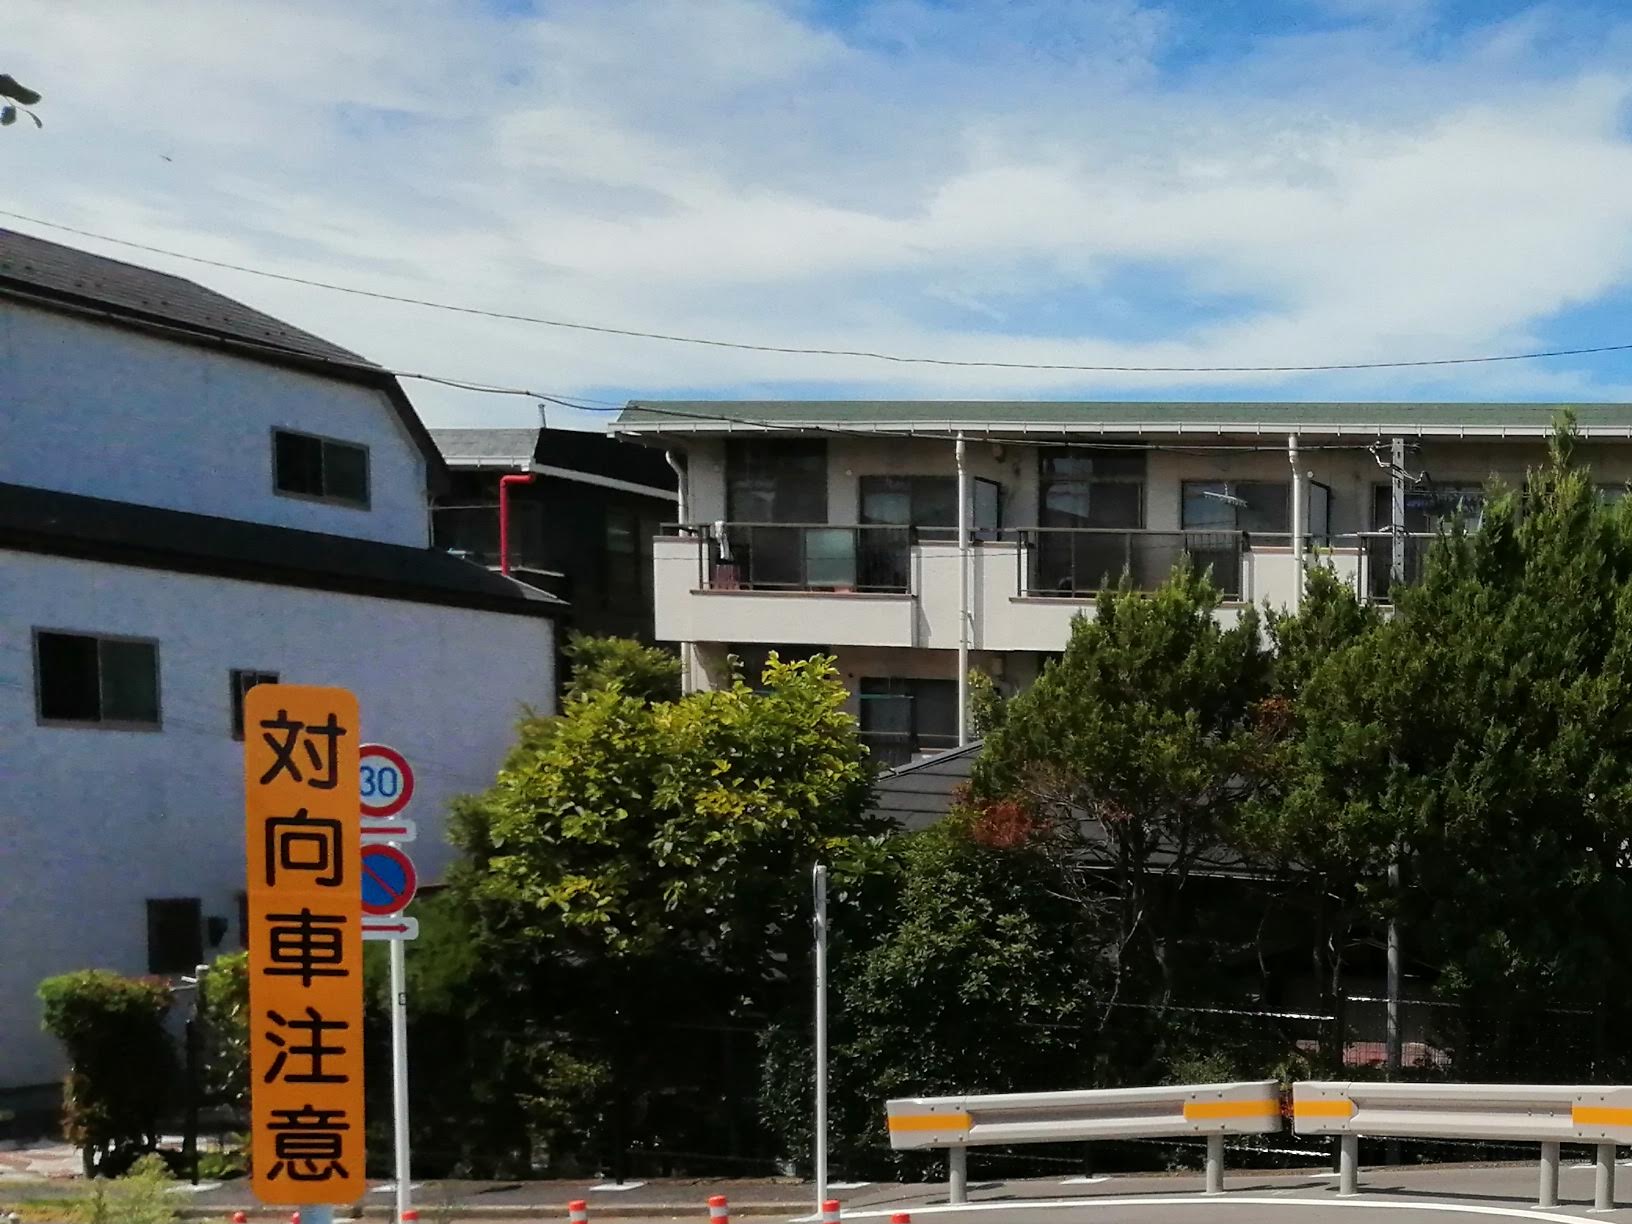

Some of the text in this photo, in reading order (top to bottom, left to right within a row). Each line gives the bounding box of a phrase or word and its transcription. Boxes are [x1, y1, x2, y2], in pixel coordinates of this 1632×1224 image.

[360, 766, 398, 798] 30
[260, 709, 350, 1181] 対向車注意
